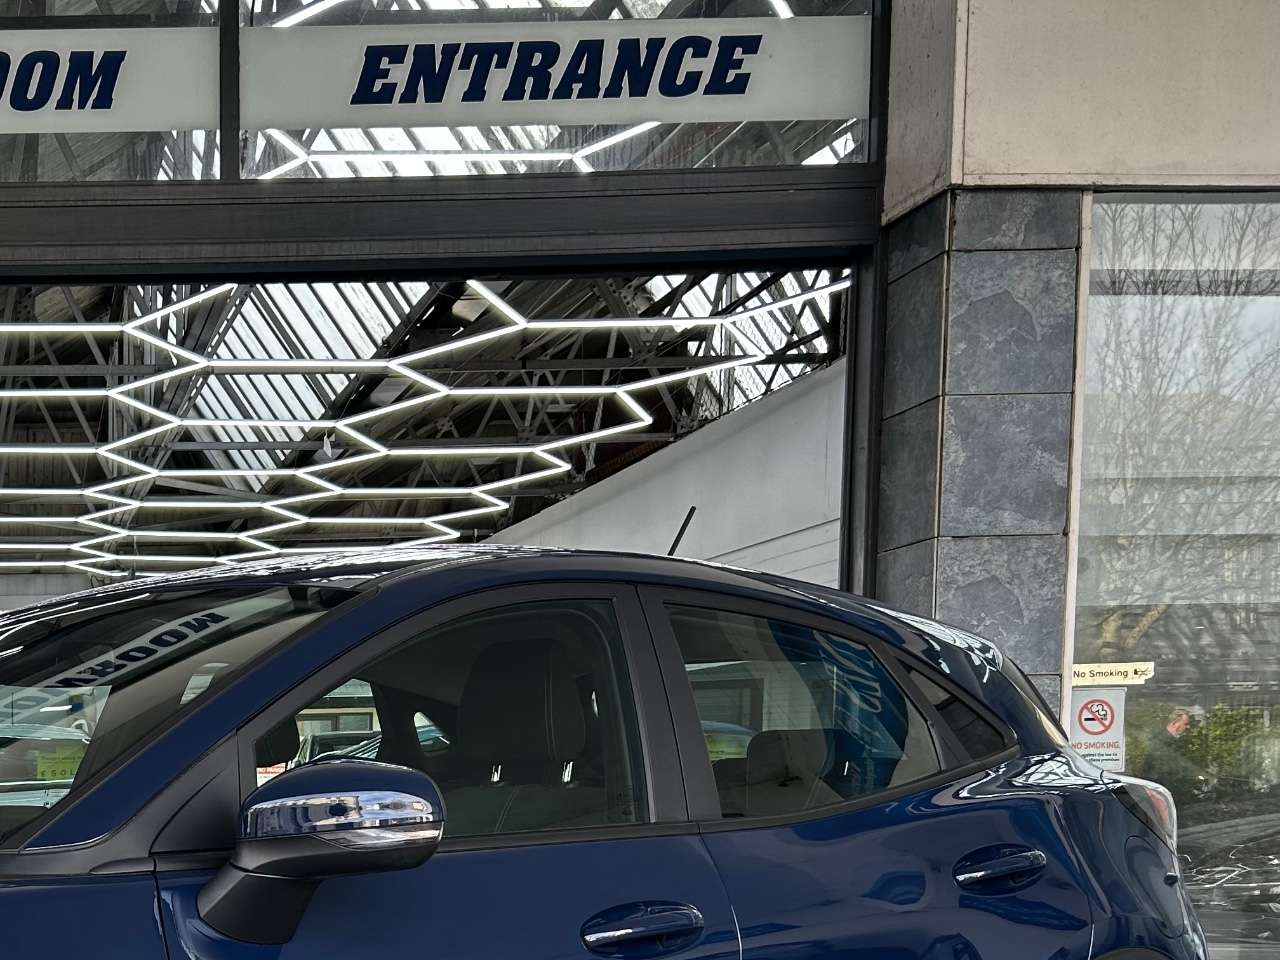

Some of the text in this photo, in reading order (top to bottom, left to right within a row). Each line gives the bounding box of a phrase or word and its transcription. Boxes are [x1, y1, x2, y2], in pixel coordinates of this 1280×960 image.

[349, 34, 763, 105] ENTRANCE
[1073, 669, 1129, 678] No Smoking
[1084, 741, 1120, 749] SMOKING
